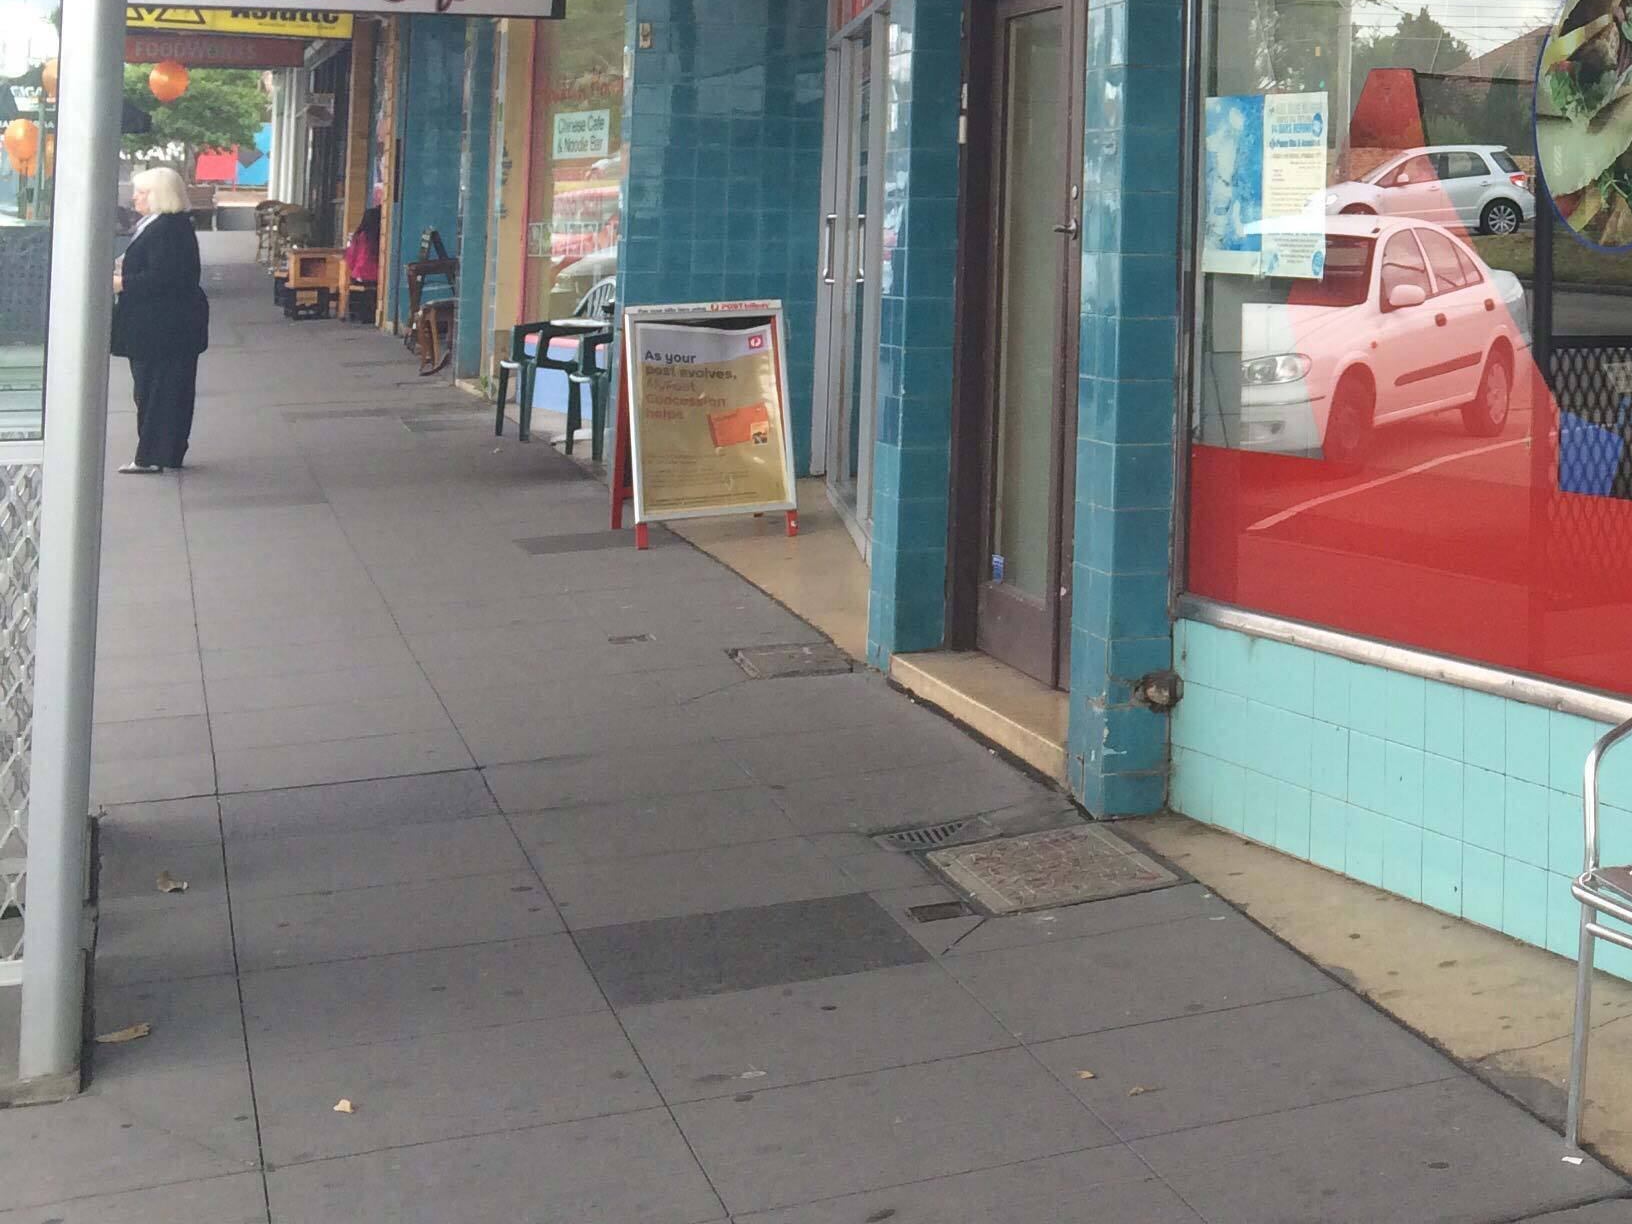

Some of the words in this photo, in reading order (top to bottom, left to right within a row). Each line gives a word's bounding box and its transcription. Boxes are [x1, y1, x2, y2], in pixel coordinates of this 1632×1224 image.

[588, 115, 605, 132] Cafe
[645, 350, 662, 361] As
[665, 353, 697, 364] your
[645, 366, 676, 378] post
[645, 393, 727, 408] Concession
